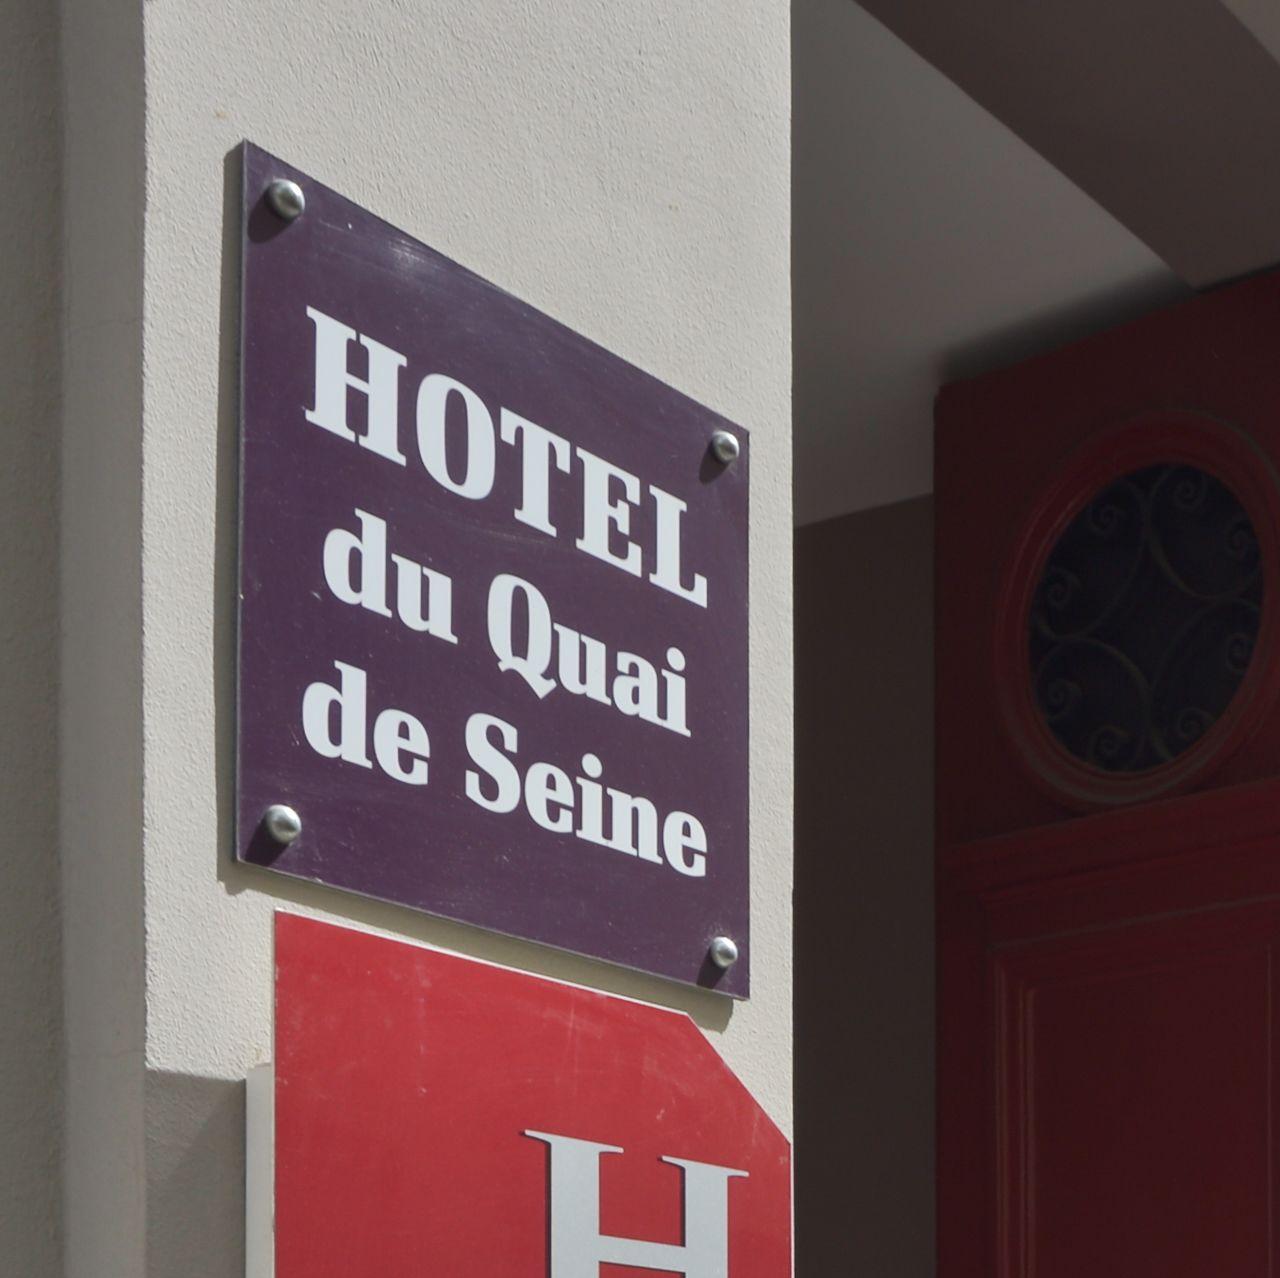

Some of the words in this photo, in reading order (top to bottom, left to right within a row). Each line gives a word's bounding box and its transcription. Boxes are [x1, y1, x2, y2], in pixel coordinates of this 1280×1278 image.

[304, 305, 709, 610] HOTEL
[323, 508, 458, 645] du
[486, 572, 693, 739] Quai
[301, 660, 430, 786] de
[464, 712, 709, 878] Seine
